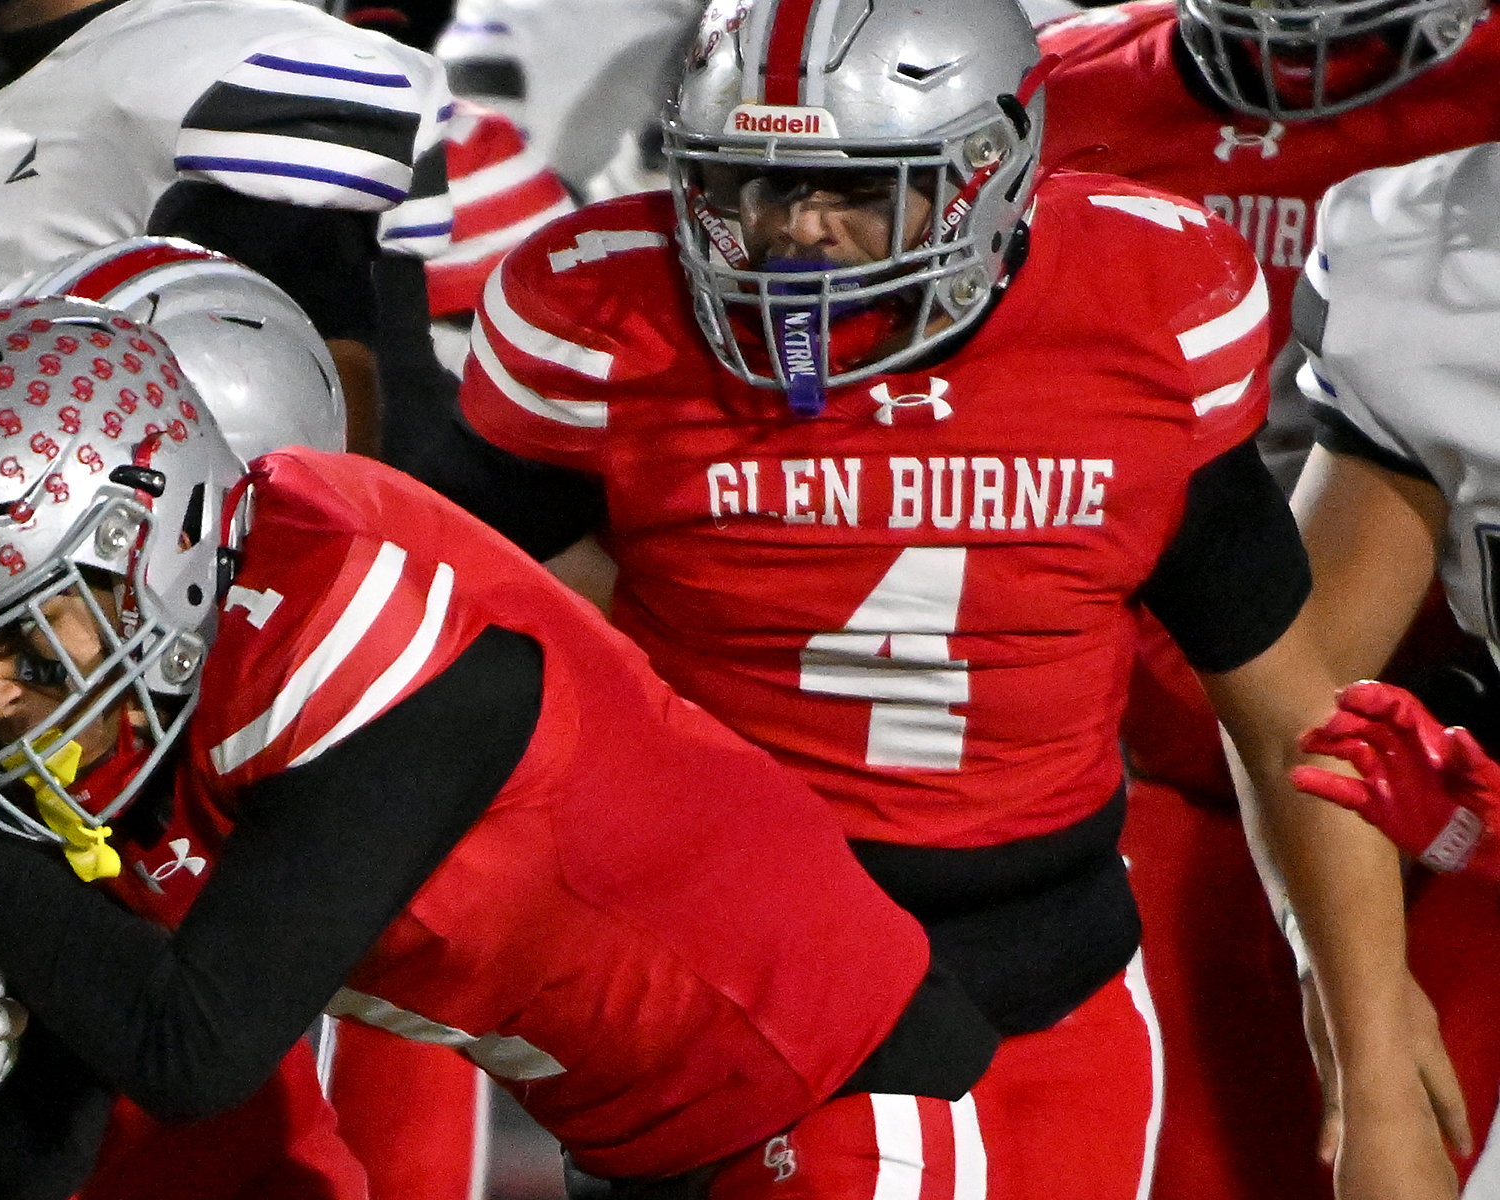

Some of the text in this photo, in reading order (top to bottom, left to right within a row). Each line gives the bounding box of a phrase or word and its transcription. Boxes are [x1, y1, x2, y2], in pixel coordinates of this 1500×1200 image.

[734, 112, 820, 134] Riddell
[706, 456, 1114, 530] GLEN BURNIE
[799, 546, 970, 771] 4
